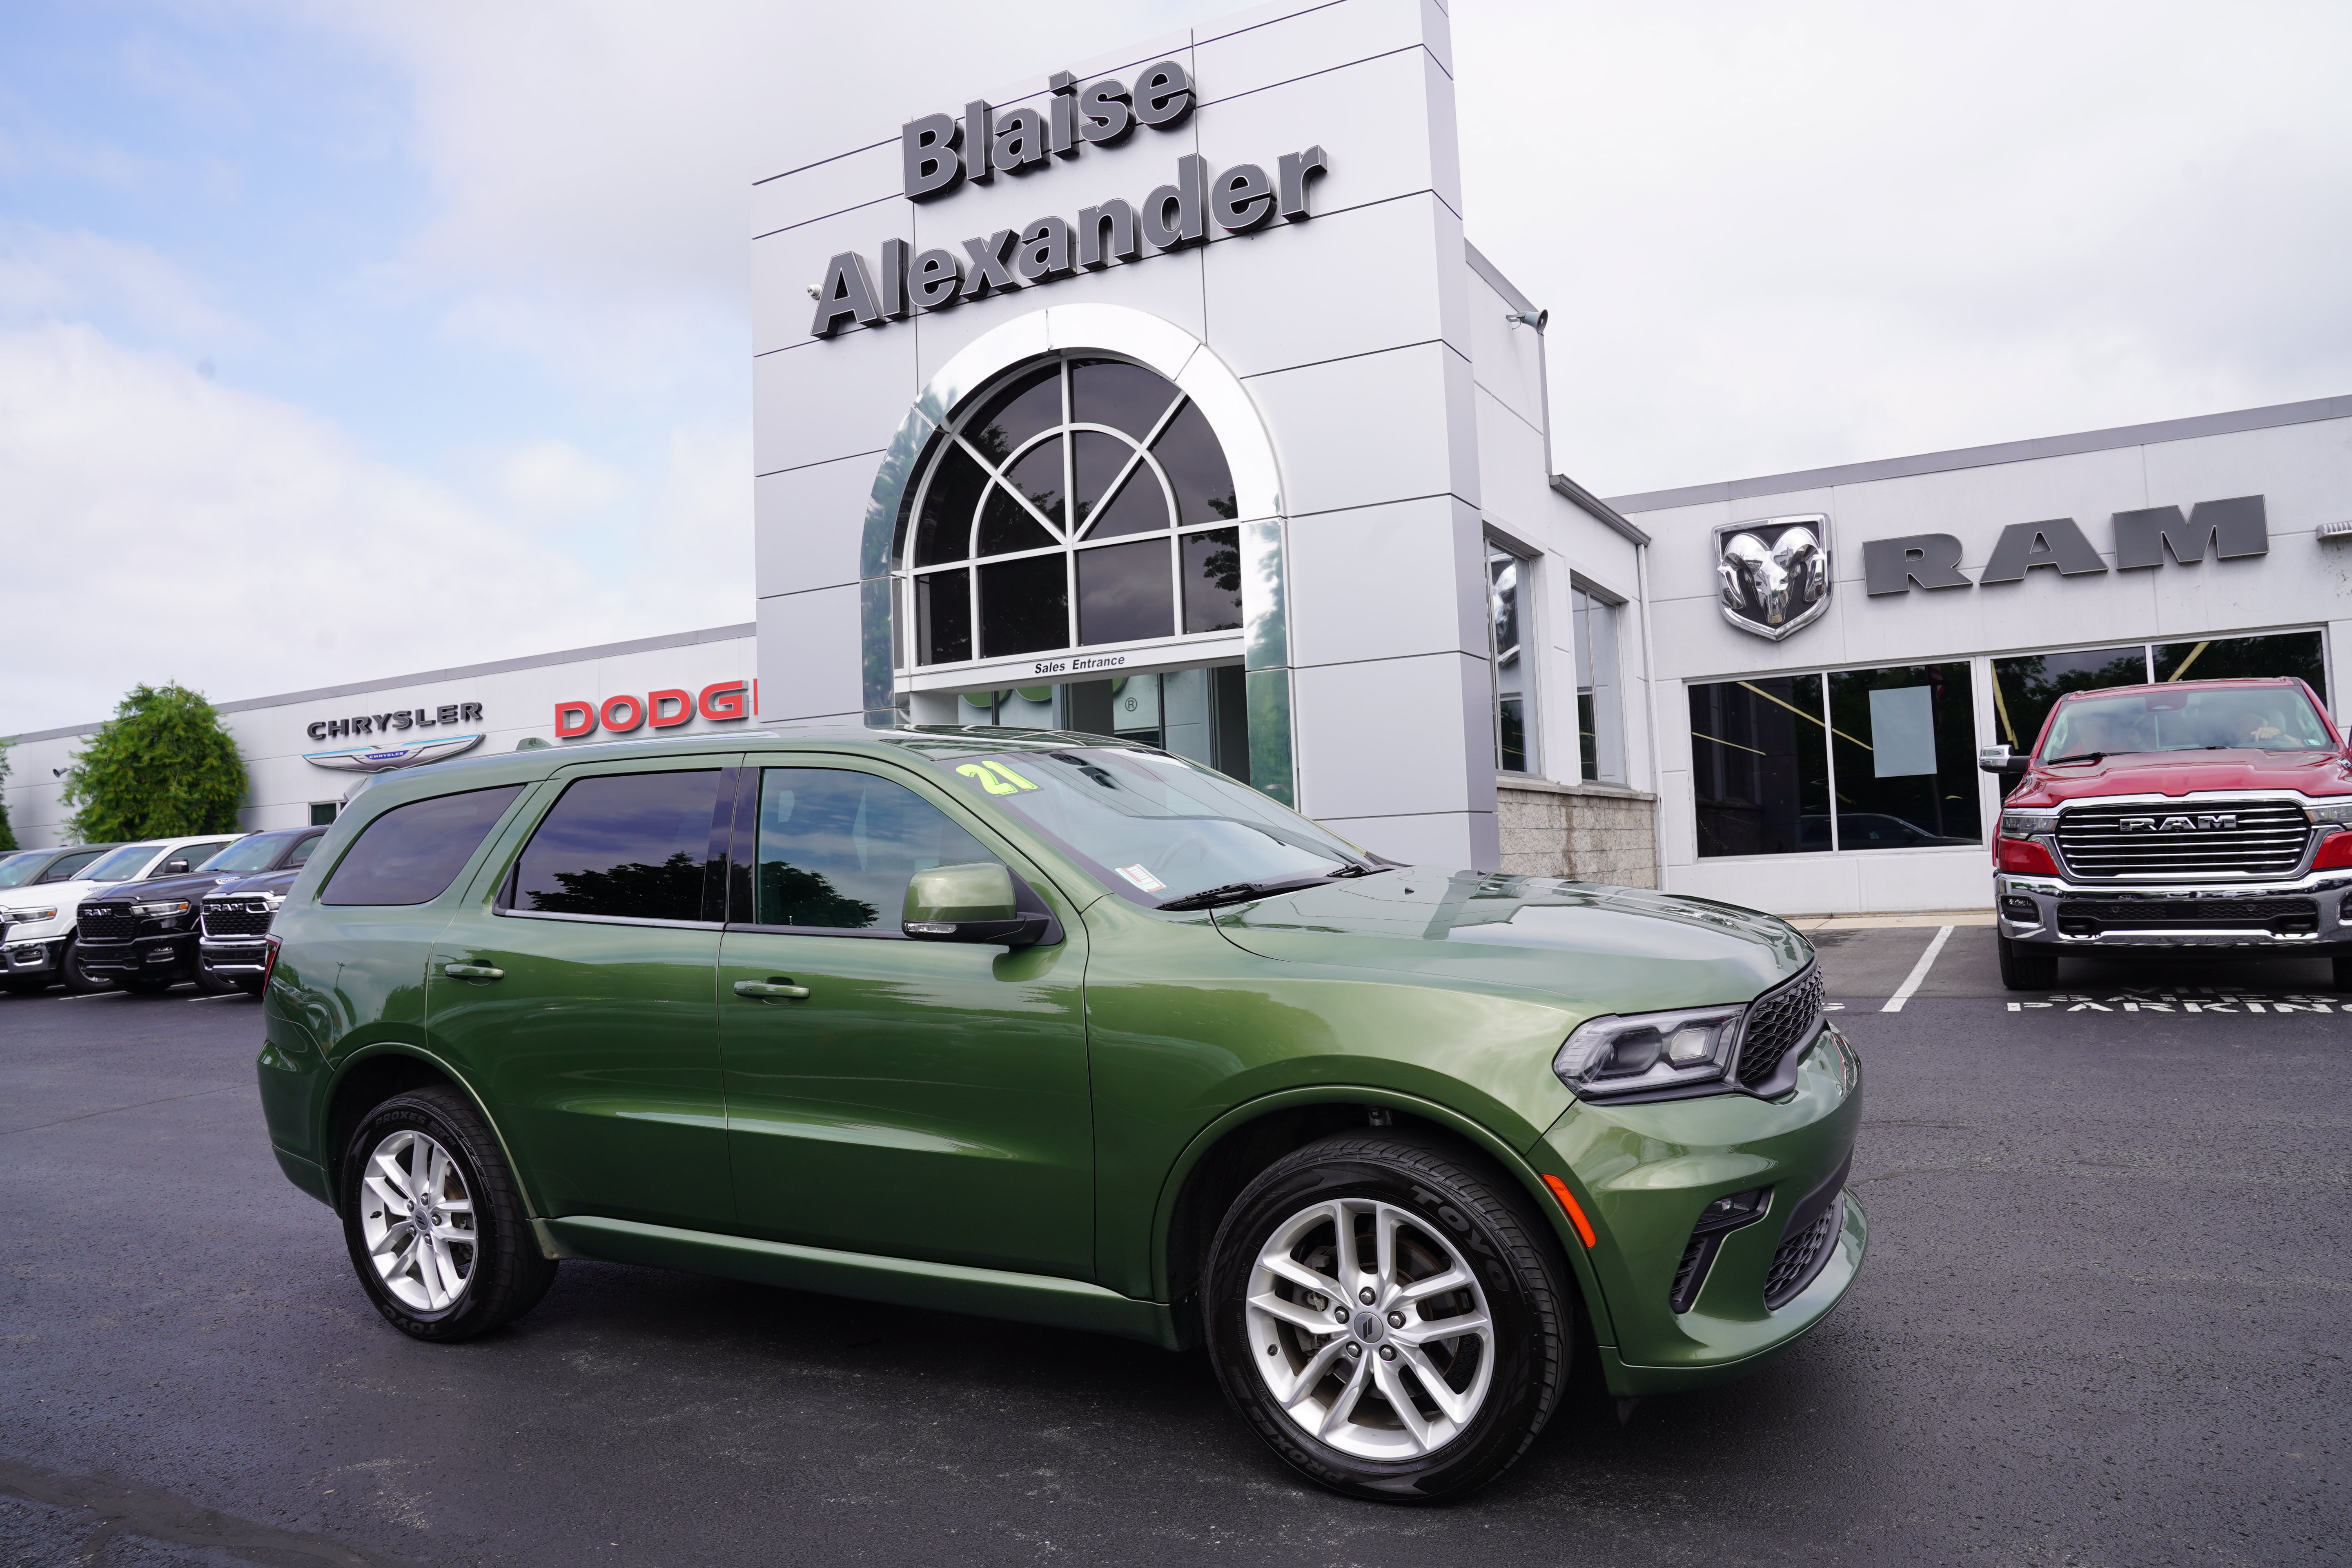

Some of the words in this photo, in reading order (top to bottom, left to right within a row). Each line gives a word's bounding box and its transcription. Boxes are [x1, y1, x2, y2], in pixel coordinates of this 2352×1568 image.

[902, 60, 1197, 202] Blaise
[810, 145, 1327, 339] Alexander
[1862, 494, 2269, 595] RAM
[1035, 662, 1065, 674] Sales
[1072, 657, 1125, 670] Entrance
[307, 702, 483, 739] CHRYSLER
[555, 678, 757, 737] DODG
[956, 760, 1038, 795] 21
[2120, 815, 2237, 831] RAM
[210, 903, 244, 911] RAM
[2007, 1002, 2352, 1013] PARKIN
[2047, 994, 2338, 1002] SALES
[375, 1111, 428, 1128] PROXES
[1411, 1185, 1510, 1292] TOYO
[382, 1304, 440, 1334] TOYO
[1245, 1406, 1346, 1483] PROXES
